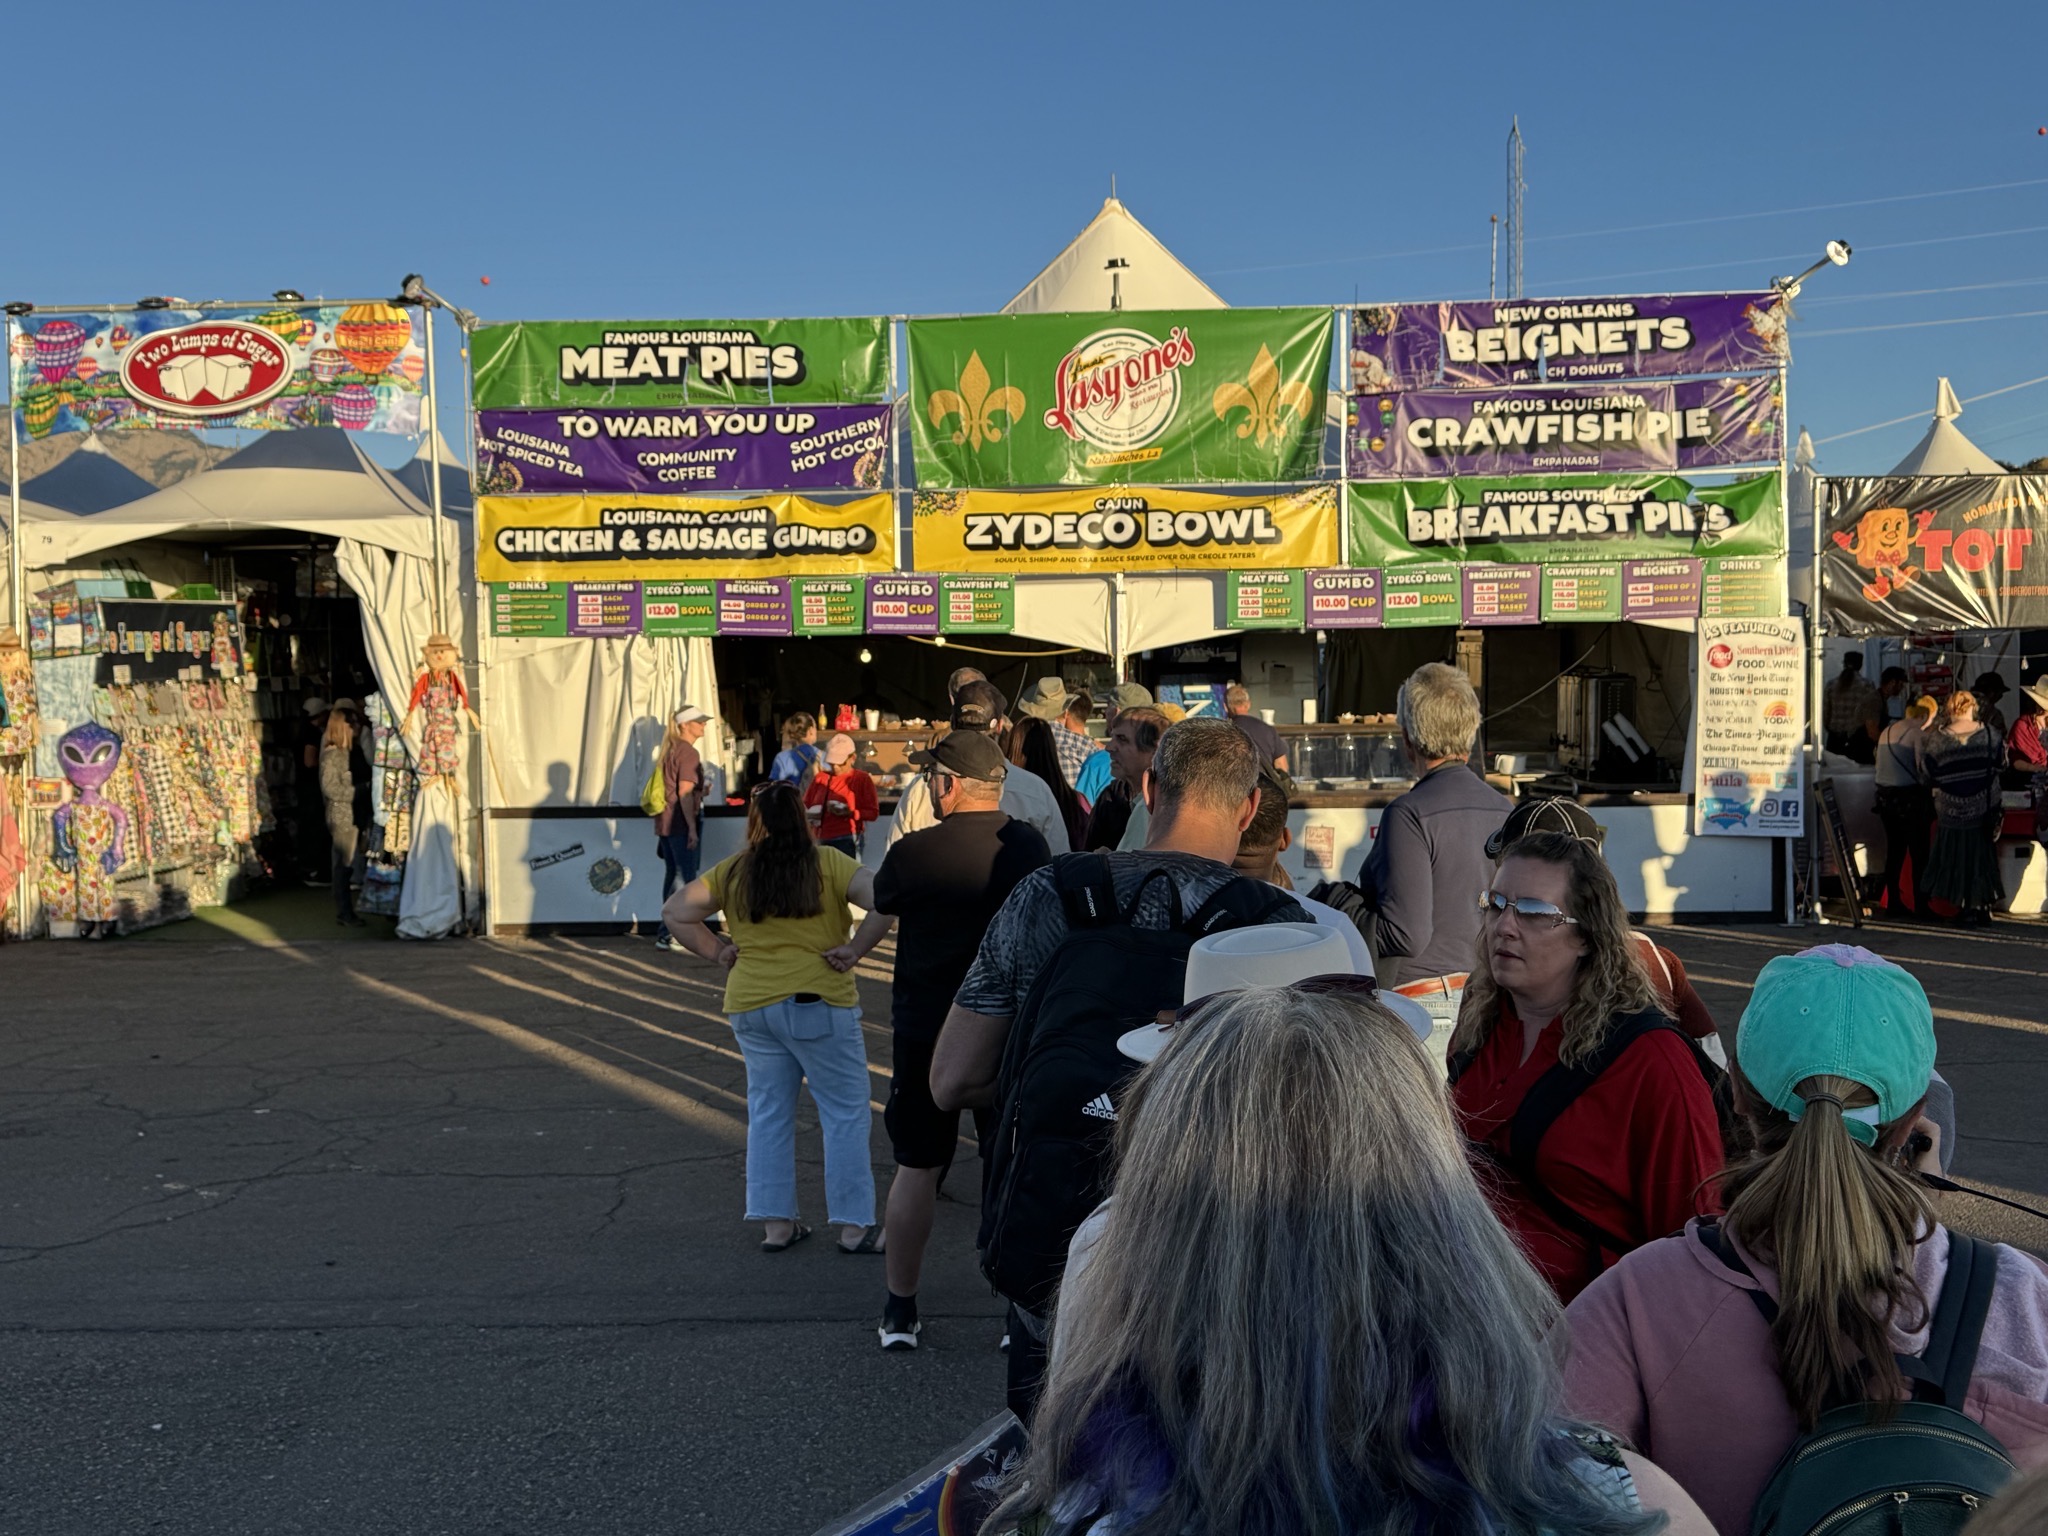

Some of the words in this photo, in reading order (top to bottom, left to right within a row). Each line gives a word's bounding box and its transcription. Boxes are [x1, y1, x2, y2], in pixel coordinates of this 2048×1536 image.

[1494, 306, 1541, 323] NEW
[1544, 303, 1635, 321] ORLEANS
[604, 331, 670, 346] FAMOUS
[672, 331, 755, 345] LOUISIANA
[1445, 316, 1691, 364] BEIGNETS
[135, 342, 170, 369] Two
[170, 333, 220, 353] Lumps
[222, 330, 240, 349] of
[236, 331, 281, 367] Sugar
[561, 345, 689, 380] MEAT
[700, 345, 799, 380] PIES
[1513, 366, 1566, 382] FRCH
[1569, 363, 1624, 377] DONUTS
[1044, 326, 1194, 440] Lasyone's
[1473, 398, 1547, 414] FAMOUS
[1551, 395, 1646, 412] LOUISIANA
[557, 415, 599, 438] TO
[604, 415, 697, 438] WARM
[705, 414, 768, 436] YOU
[774, 413, 816, 434] UP
[1407, 411, 1636, 448] CRAWFISH
[1646, 408, 1713, 441] PIE
[790, 416, 881, 455] SOUTHERN
[497, 426, 571, 459] LOUISIANA
[478, 436, 506, 454] HOT
[506, 445, 556, 469] SPICED
[557, 459, 584, 479] TEA
[636, 447, 738, 467] COMMUNITY
[791, 451, 827, 473] HOT
[830, 435, 885, 461] COCOA
[1533, 456, 1600, 467] EMPANADAS
[657, 466, 717, 484] COFFEE
[1483, 490, 1550, 504] FAMOUS
[1094, 497, 1144, 511] CAJUN
[603, 510, 703, 526] LOUISIANA
[706, 508, 768, 524] CAJUN
[1406, 503, 1635, 542] BREAKFAST
[965, 511, 1136, 547] ZYDECO
[1147, 508, 1277, 542] BOWL
[41, 535, 53, 545] 79
[497, 529, 615, 554] CHICKEN
[618, 530, 642, 552] &
[646, 527, 769, 552] SAUSAGE
[773, 525, 868, 550] GUMBO
[1915, 528, 2033, 573] TOT
[1126, 554, 1156, 562] SERVED
[1546, 567, 1598, 576] CRAWFISH
[1599, 567, 1616, 576] PIE
[1632, 565, 1690, 577] BEIGNETS
[1719, 560, 1762, 571] DRINKS
[1238, 575, 1267, 583] MEAT
[1267, 574, 1290, 583] PIES
[1386, 574, 1423, 585] ZYDECO
[1425, 573, 1453, 583] BOWL
[1468, 571, 1513, 580] BREAKFAST
[1513, 570, 1532, 579] PIES
[508, 581, 548, 591] DRINKS
[573, 583, 616, 591] BREAKFAST
[616, 583, 635, 591] PIES
[725, 584, 780, 595] BEIGNETS
[802, 584, 829, 592] MEAT
[830, 583, 853, 592] PIES
[943, 581, 993, 589] CRAWFISH
[993, 581, 1009, 589] PIE
[1313, 577, 1375, 589] GUMBO
[645, 586, 682, 595] ZYDECO
[683, 585, 710, 595] BOWL
[872, 584, 933, 596] GUMBO
[1315, 598, 1346, 608] $10.00
[1350, 597, 1377, 608] CUP
[1388, 595, 1418, 606] $12.00
[1422, 594, 1456, 604] BOWL
[648, 606, 677, 615] $12.00
[681, 606, 713, 615] BOWL
[875, 605, 905, 614] $10.00
[909, 604, 935, 614] CUP
[1705, 625, 1721, 641] AS
[1722, 622, 1781, 637] FEATURED
[1780, 628, 1796, 643] IN
[117, 621, 162, 663] Lumps
[163, 620, 177, 653] of
[175, 620, 212, 660] Sugar
[1737, 645, 1774, 656] Southern
[1774, 645, 1800, 658] Living
[1736, 659, 1766, 669] FOOD
[1772, 660, 1800, 670] WINE
[1710, 672, 1725, 683] The
[1727, 673, 1745, 682] New
[1747, 672, 1767, 685] York
[1768, 673, 1794, 683] Times
[1709, 687, 1745, 696] HOUSTON
[1764, 716, 1794, 725] TODAY
[1705, 728, 1723, 739] The
[1731, 744, 1758, 752] Tribune
[1081, 1106, 1119, 1121] adidas
